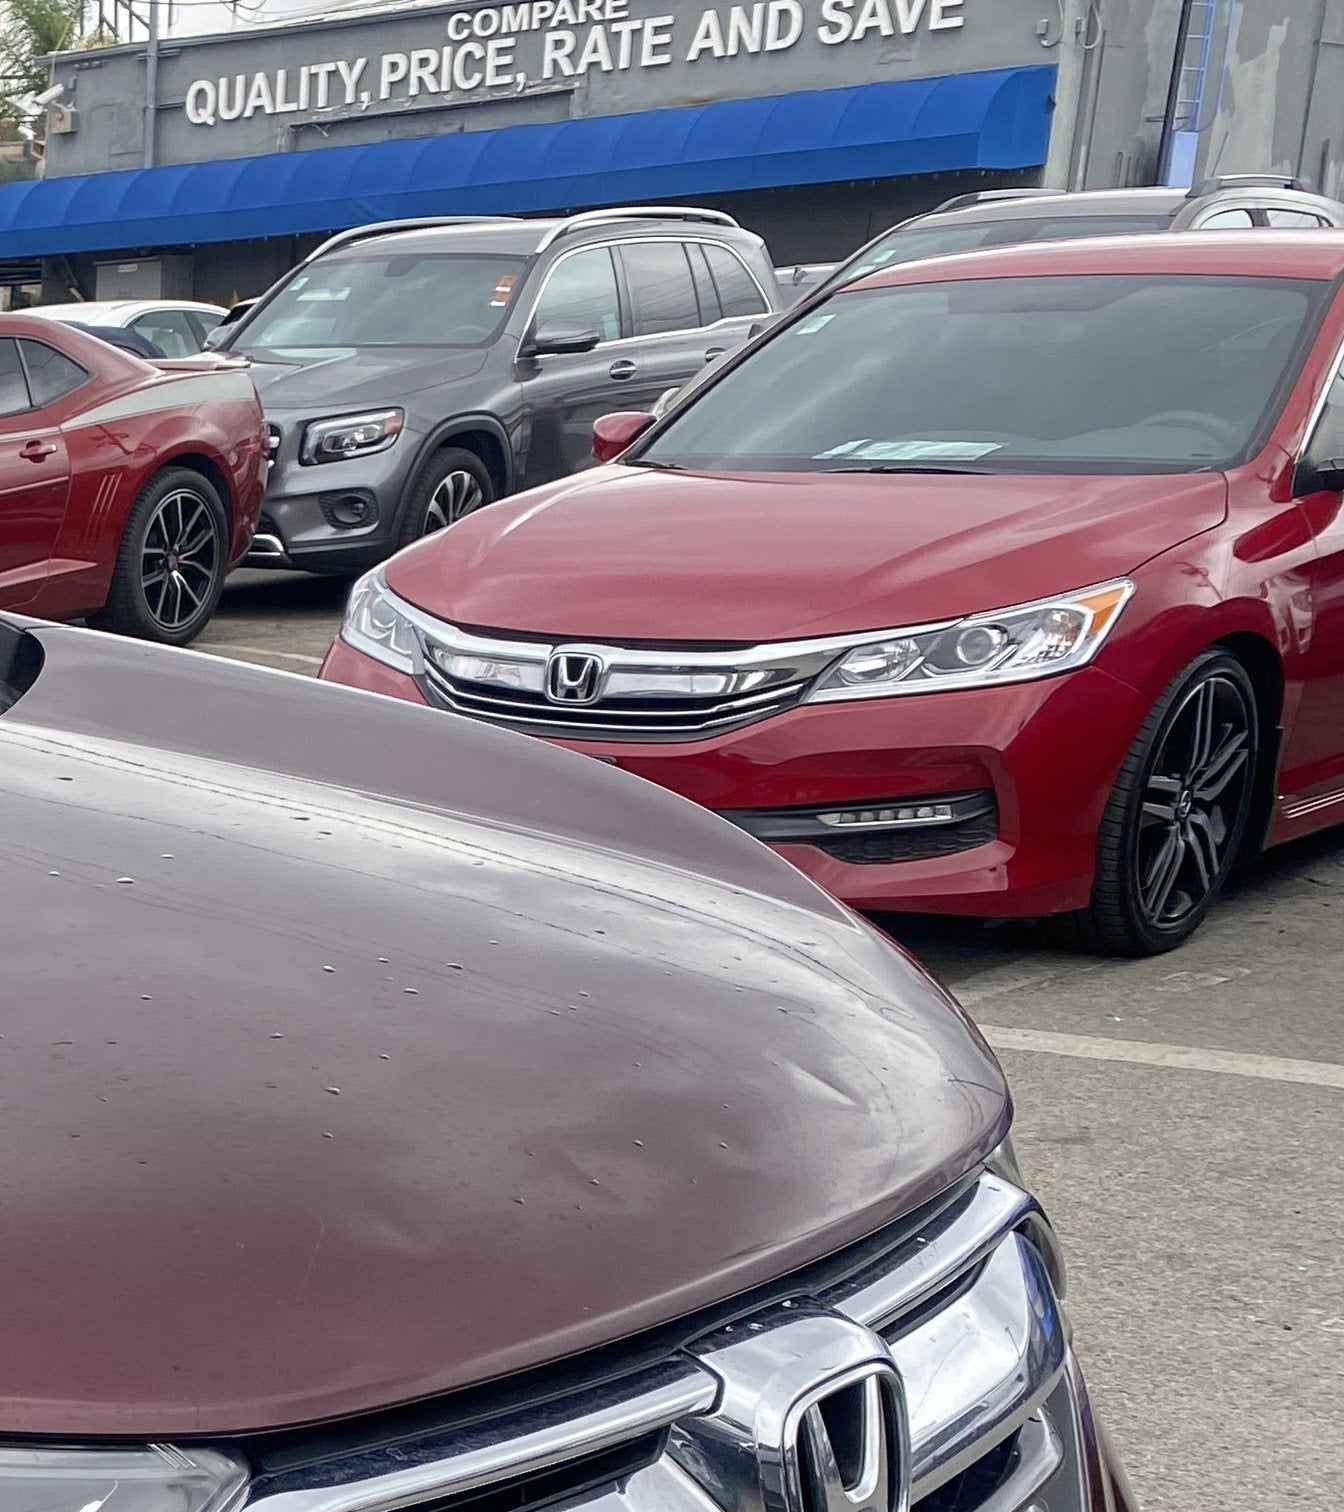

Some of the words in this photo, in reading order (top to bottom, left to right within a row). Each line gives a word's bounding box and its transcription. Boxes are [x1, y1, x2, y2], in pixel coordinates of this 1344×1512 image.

[447, 0, 630, 41] COMPARE
[185, 57, 372, 126] QUALITY,
[379, 36, 527, 100] PRICE,
[542, 14, 674, 79] RATE
[686, 0, 805, 62] AND
[817, 0, 966, 46] SAVE
